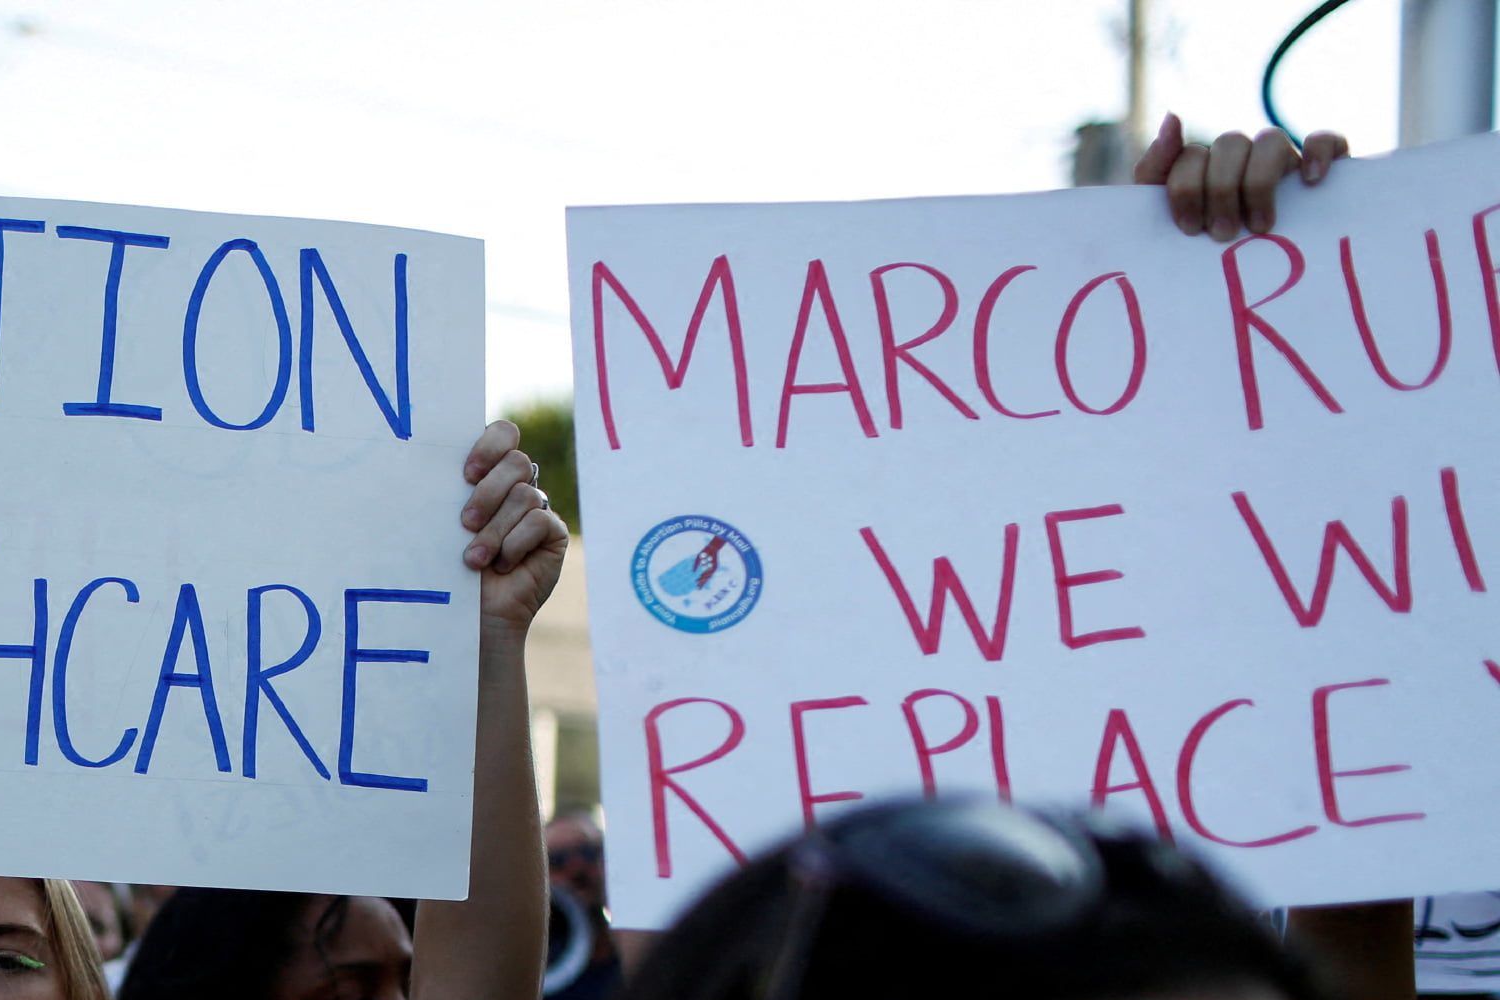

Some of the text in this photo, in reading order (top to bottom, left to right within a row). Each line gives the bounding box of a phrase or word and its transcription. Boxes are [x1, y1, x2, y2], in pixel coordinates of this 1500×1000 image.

[592, 255, 1147, 450] MARCO
[684, 519, 710, 530] Pills
[710, 522, 727, 535] by
[642, 522, 683, 556] Abortion
[728, 531, 750, 552] Mail
[636, 558, 647, 571] to
[635, 572, 654, 604] Guide
[859, 503, 1146, 662] WE
